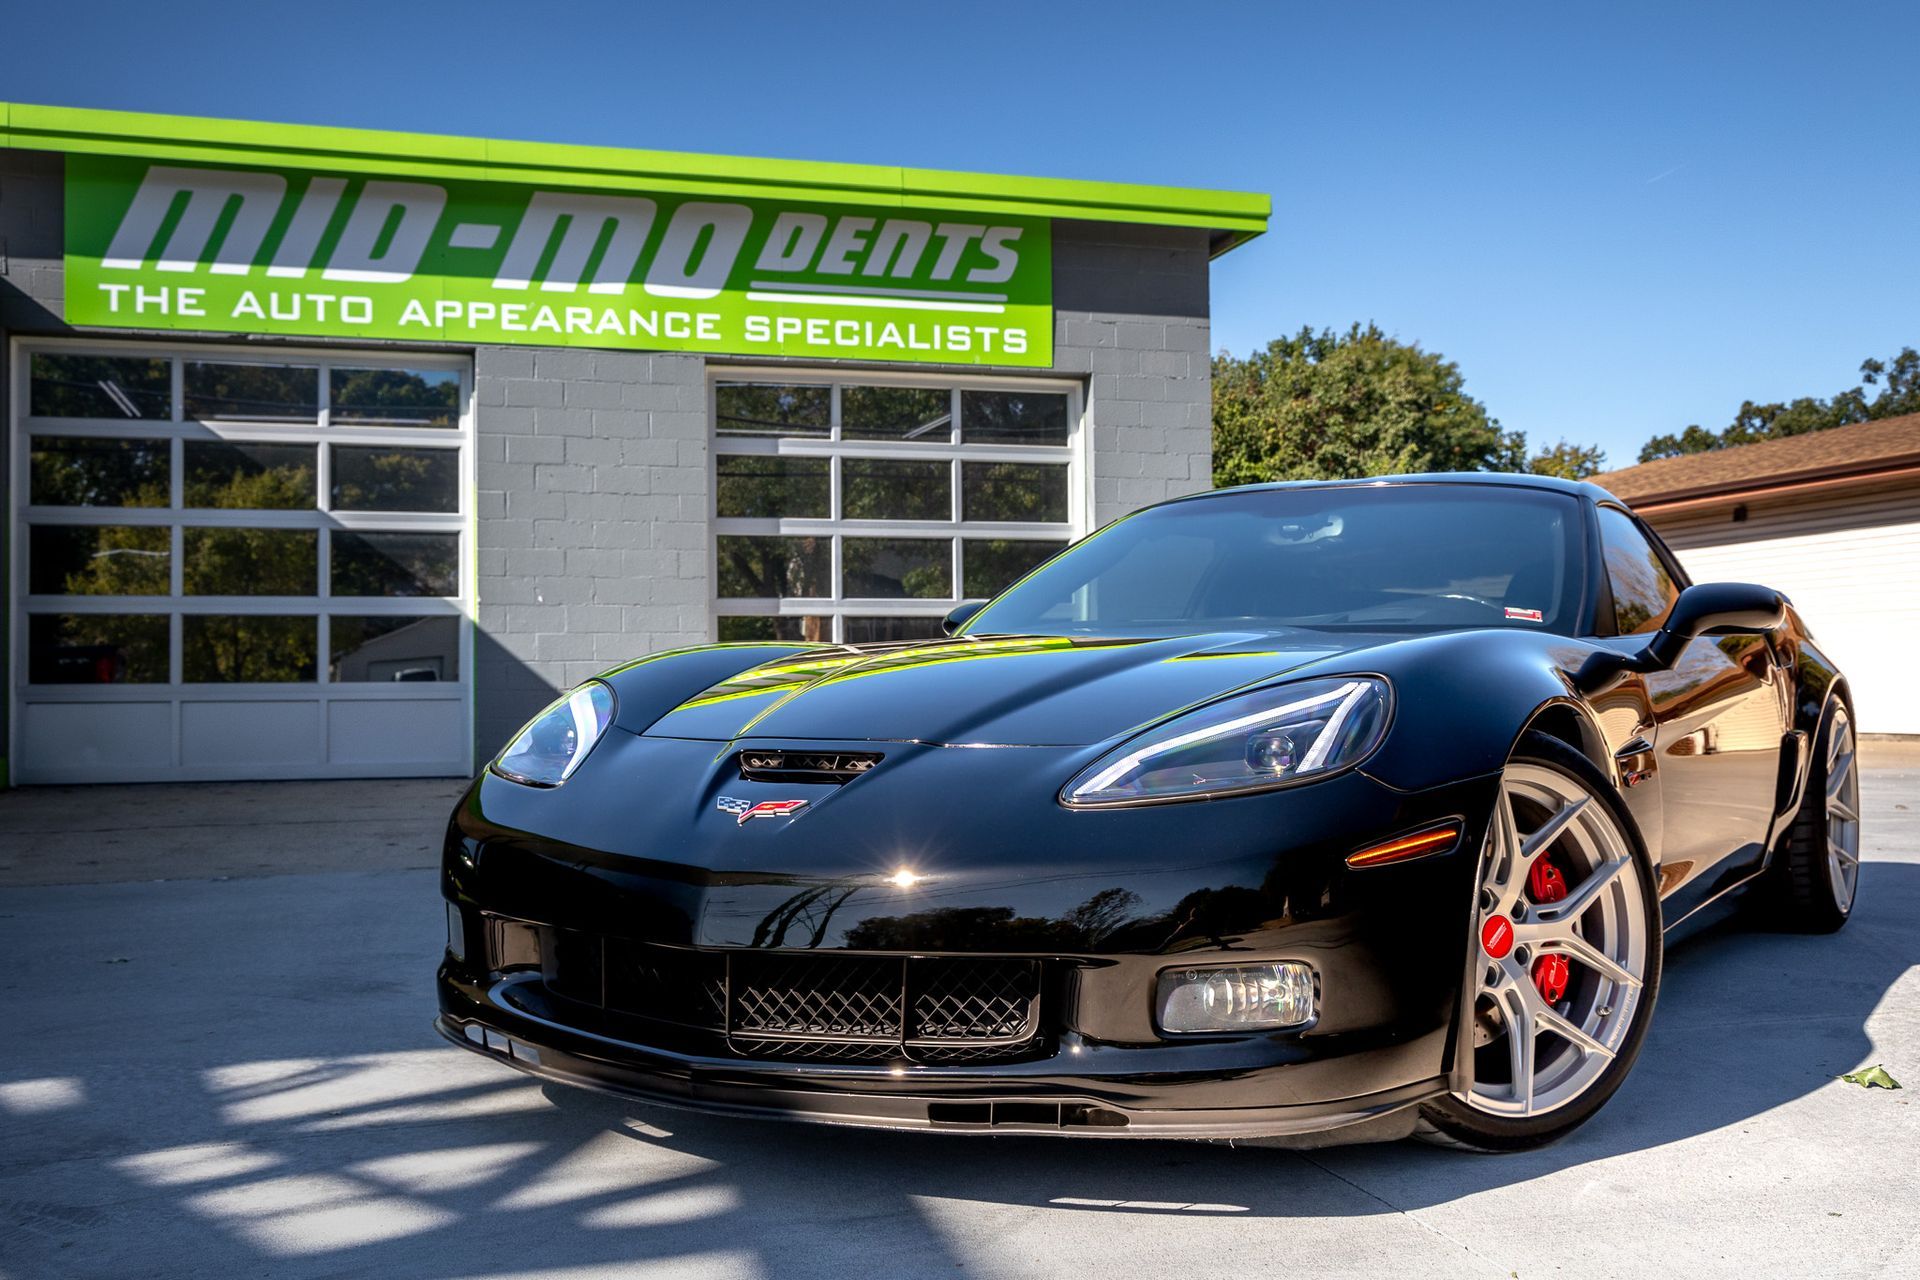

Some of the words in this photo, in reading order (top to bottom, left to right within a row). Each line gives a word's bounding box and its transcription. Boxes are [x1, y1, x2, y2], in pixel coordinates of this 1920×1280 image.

[754, 213, 1023, 283] DENTS
[98, 283, 206, 317] THE
[231, 290, 372, 325] AUTO
[398, 298, 721, 341] APPEARANCE
[744, 315, 1027, 354] SPECIALISTS
